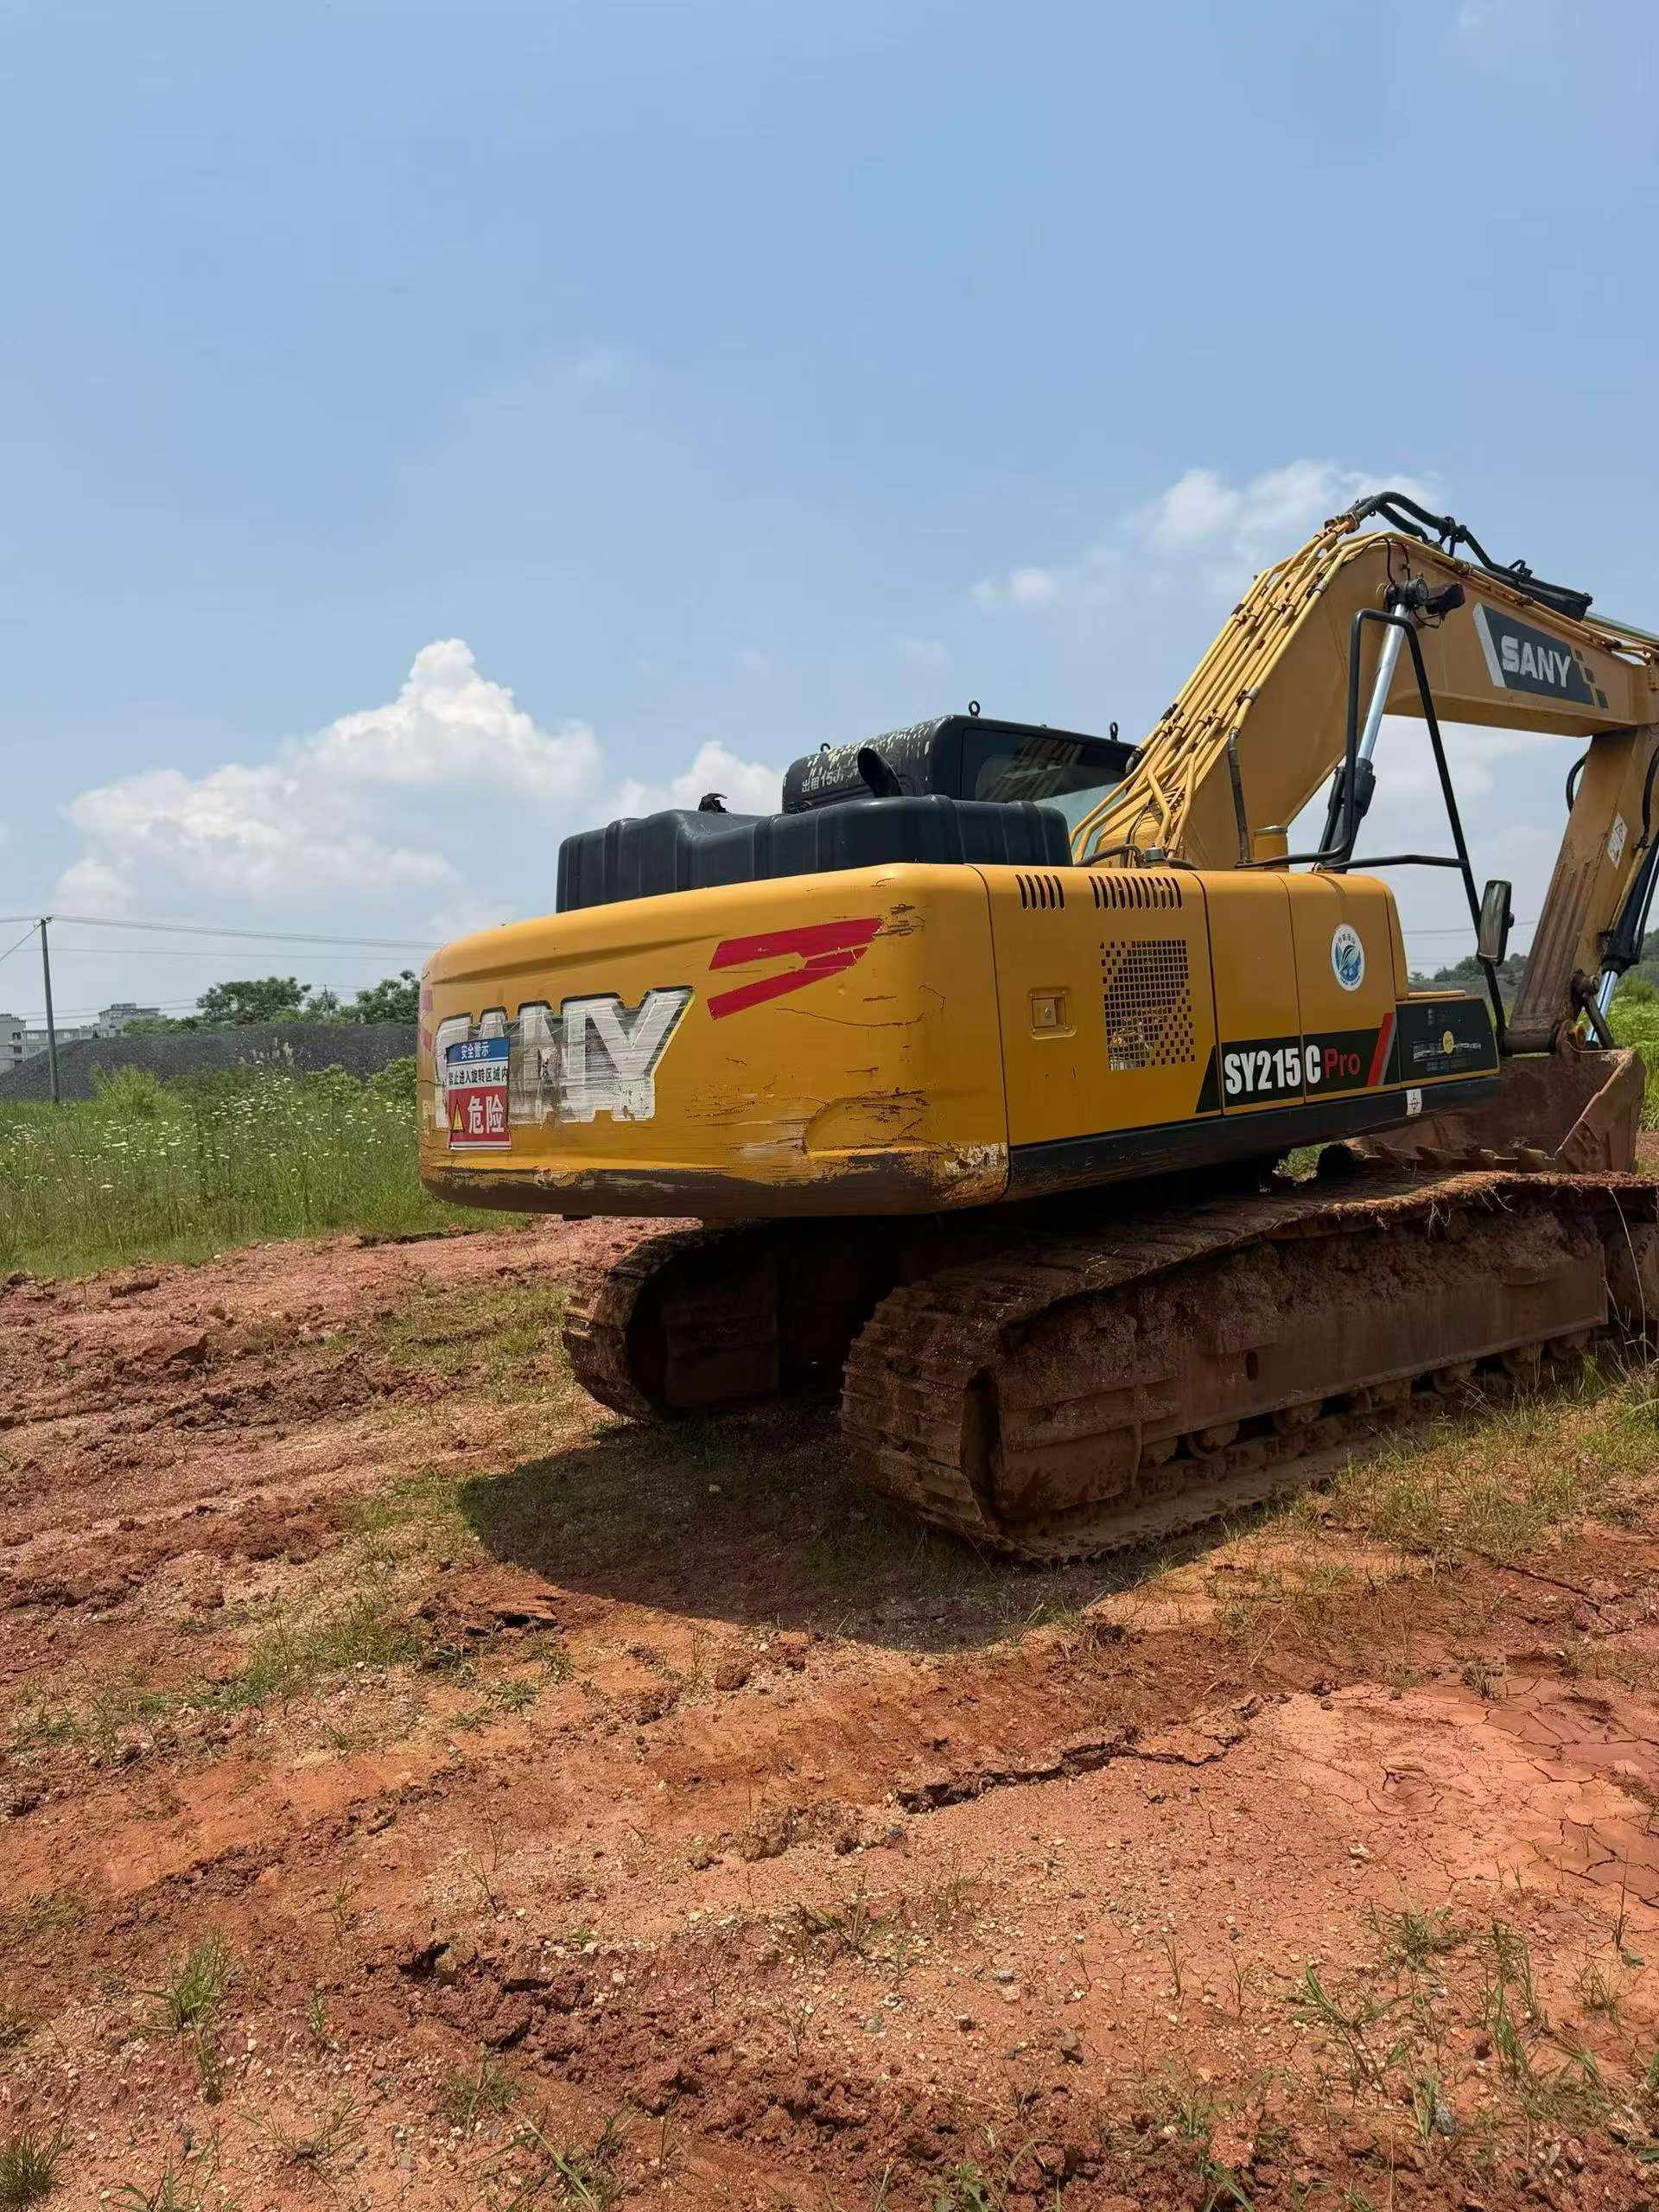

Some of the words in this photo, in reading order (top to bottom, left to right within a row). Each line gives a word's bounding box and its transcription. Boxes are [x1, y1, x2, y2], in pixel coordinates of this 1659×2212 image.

[1501, 635, 1572, 688] SANY
[461, 1040, 490, 1060] 安全警示
[1224, 1045, 1321, 1095] SY215C
[1322, 1048, 1361, 1079] Pro
[467, 1095, 505, 1135] 危险
